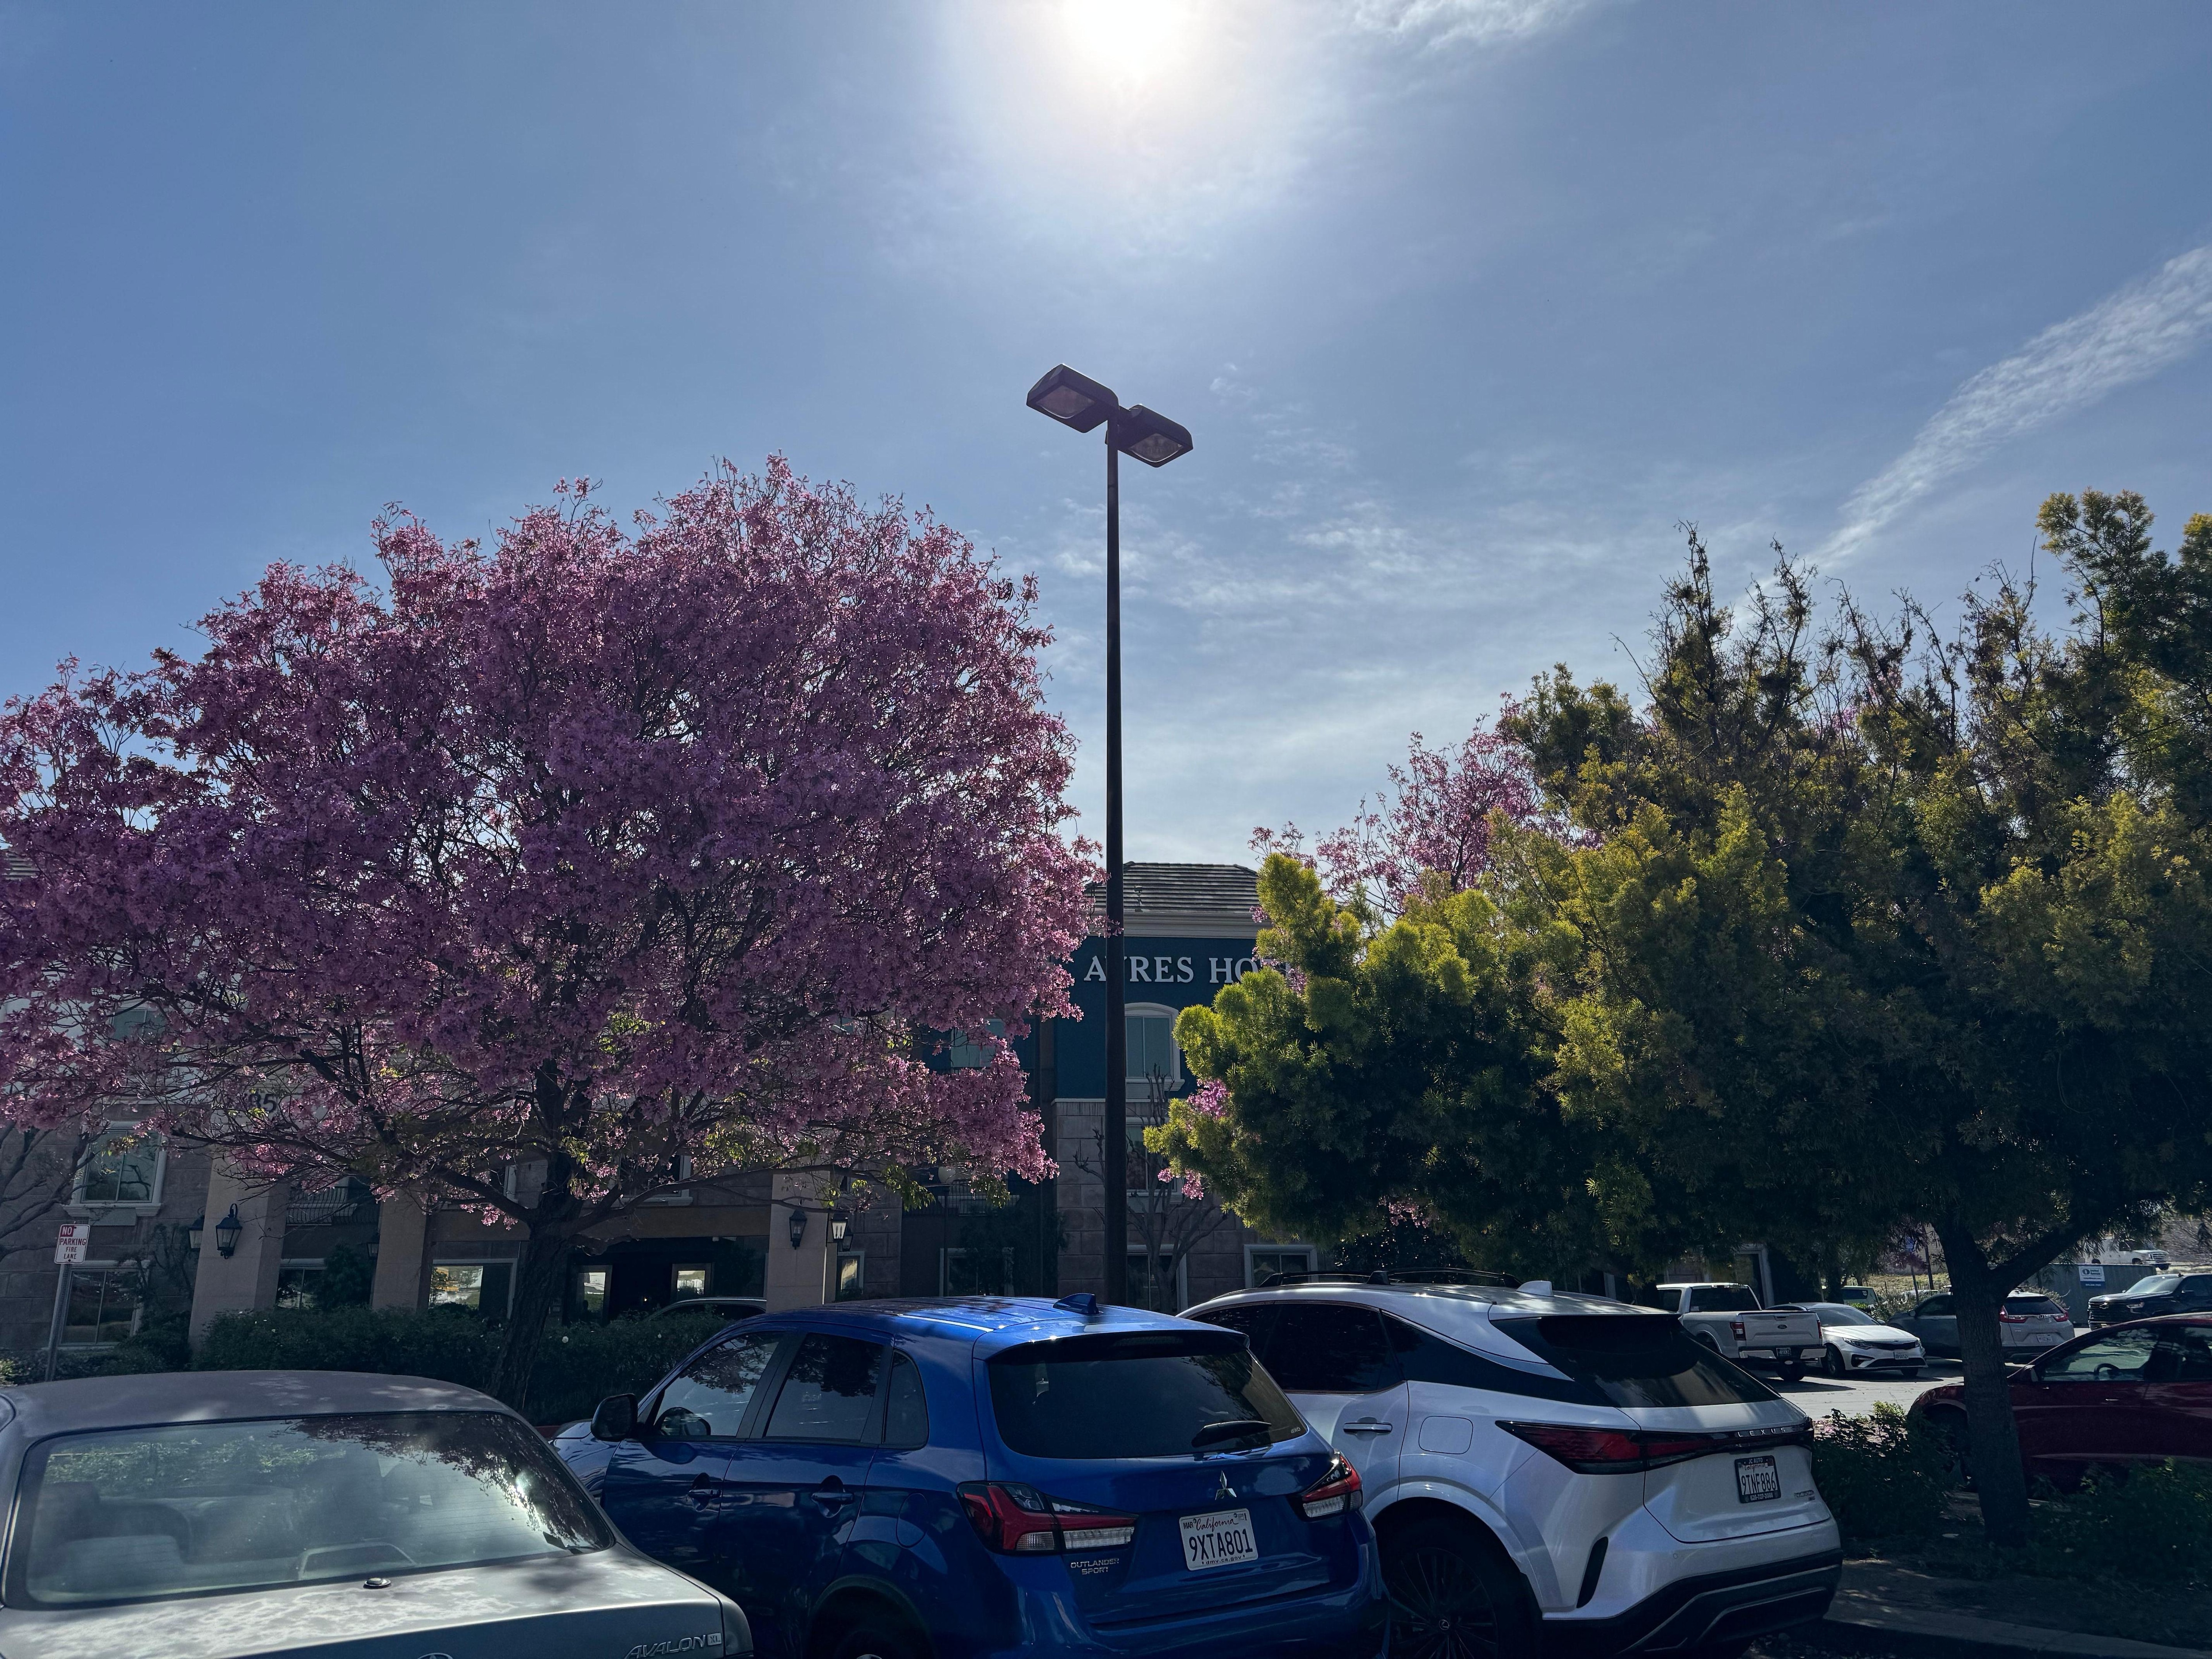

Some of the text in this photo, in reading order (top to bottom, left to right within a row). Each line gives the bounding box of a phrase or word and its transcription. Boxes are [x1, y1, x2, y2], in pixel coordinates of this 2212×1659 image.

[1083, 955, 1194, 983] ARES
[62, 1226, 73, 1235] NO
[1737, 1427, 1786, 1437] LEXUS
[1741, 1471, 1776, 1495] 9TNF886
[1183, 1521, 1194, 1530] MAR
[1196, 1517, 1239, 1532] California
[1189, 1528, 1253, 1562] 9XTA801
[1071, 1558, 1119, 1568] OUTLANDER
[1206, 1555, 1242, 1565] dmv.ca.gov
[1082, 1567, 1108, 1575] SPORT
[624, 1634, 706, 1659] AVALON
